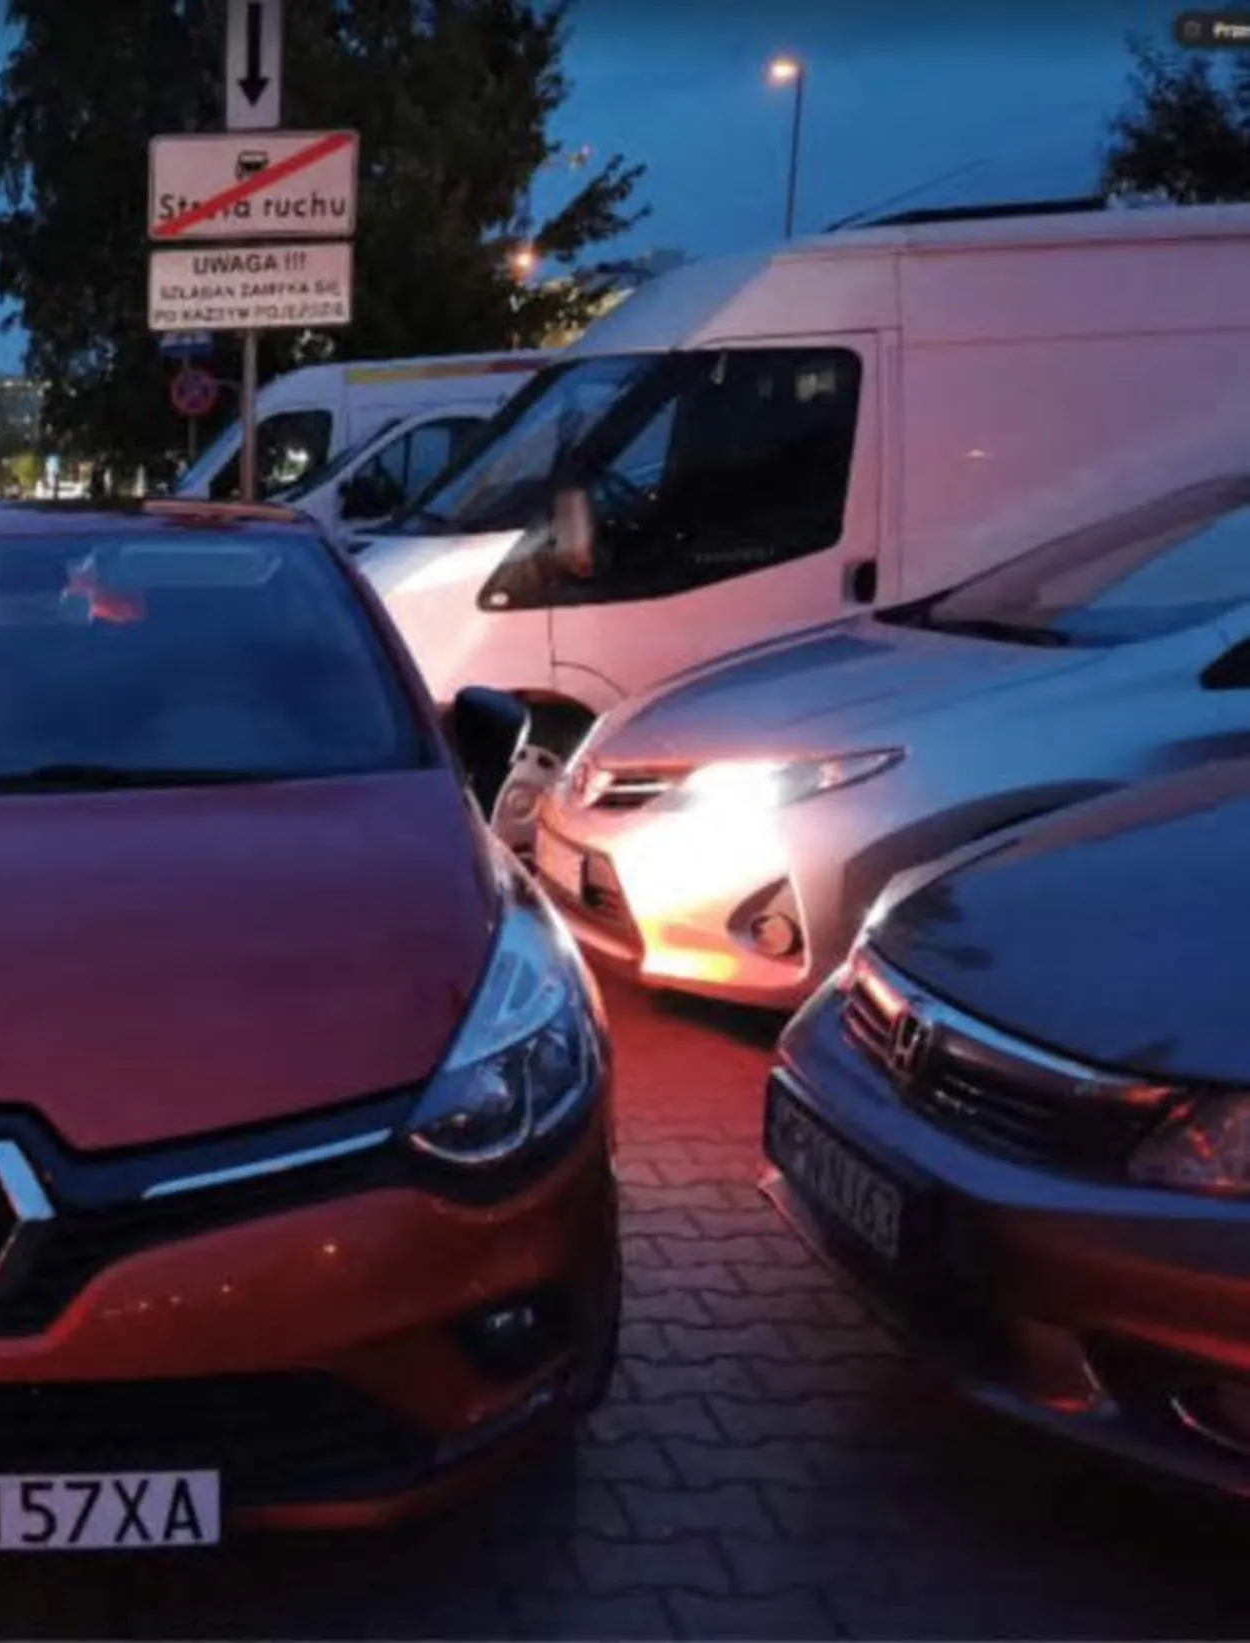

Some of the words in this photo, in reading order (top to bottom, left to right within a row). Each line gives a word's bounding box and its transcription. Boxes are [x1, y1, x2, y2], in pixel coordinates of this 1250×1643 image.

[263, 191, 346, 217] ruchu
[193, 253, 278, 274] UWAGA
[285, 251, 306, 271] !!!
